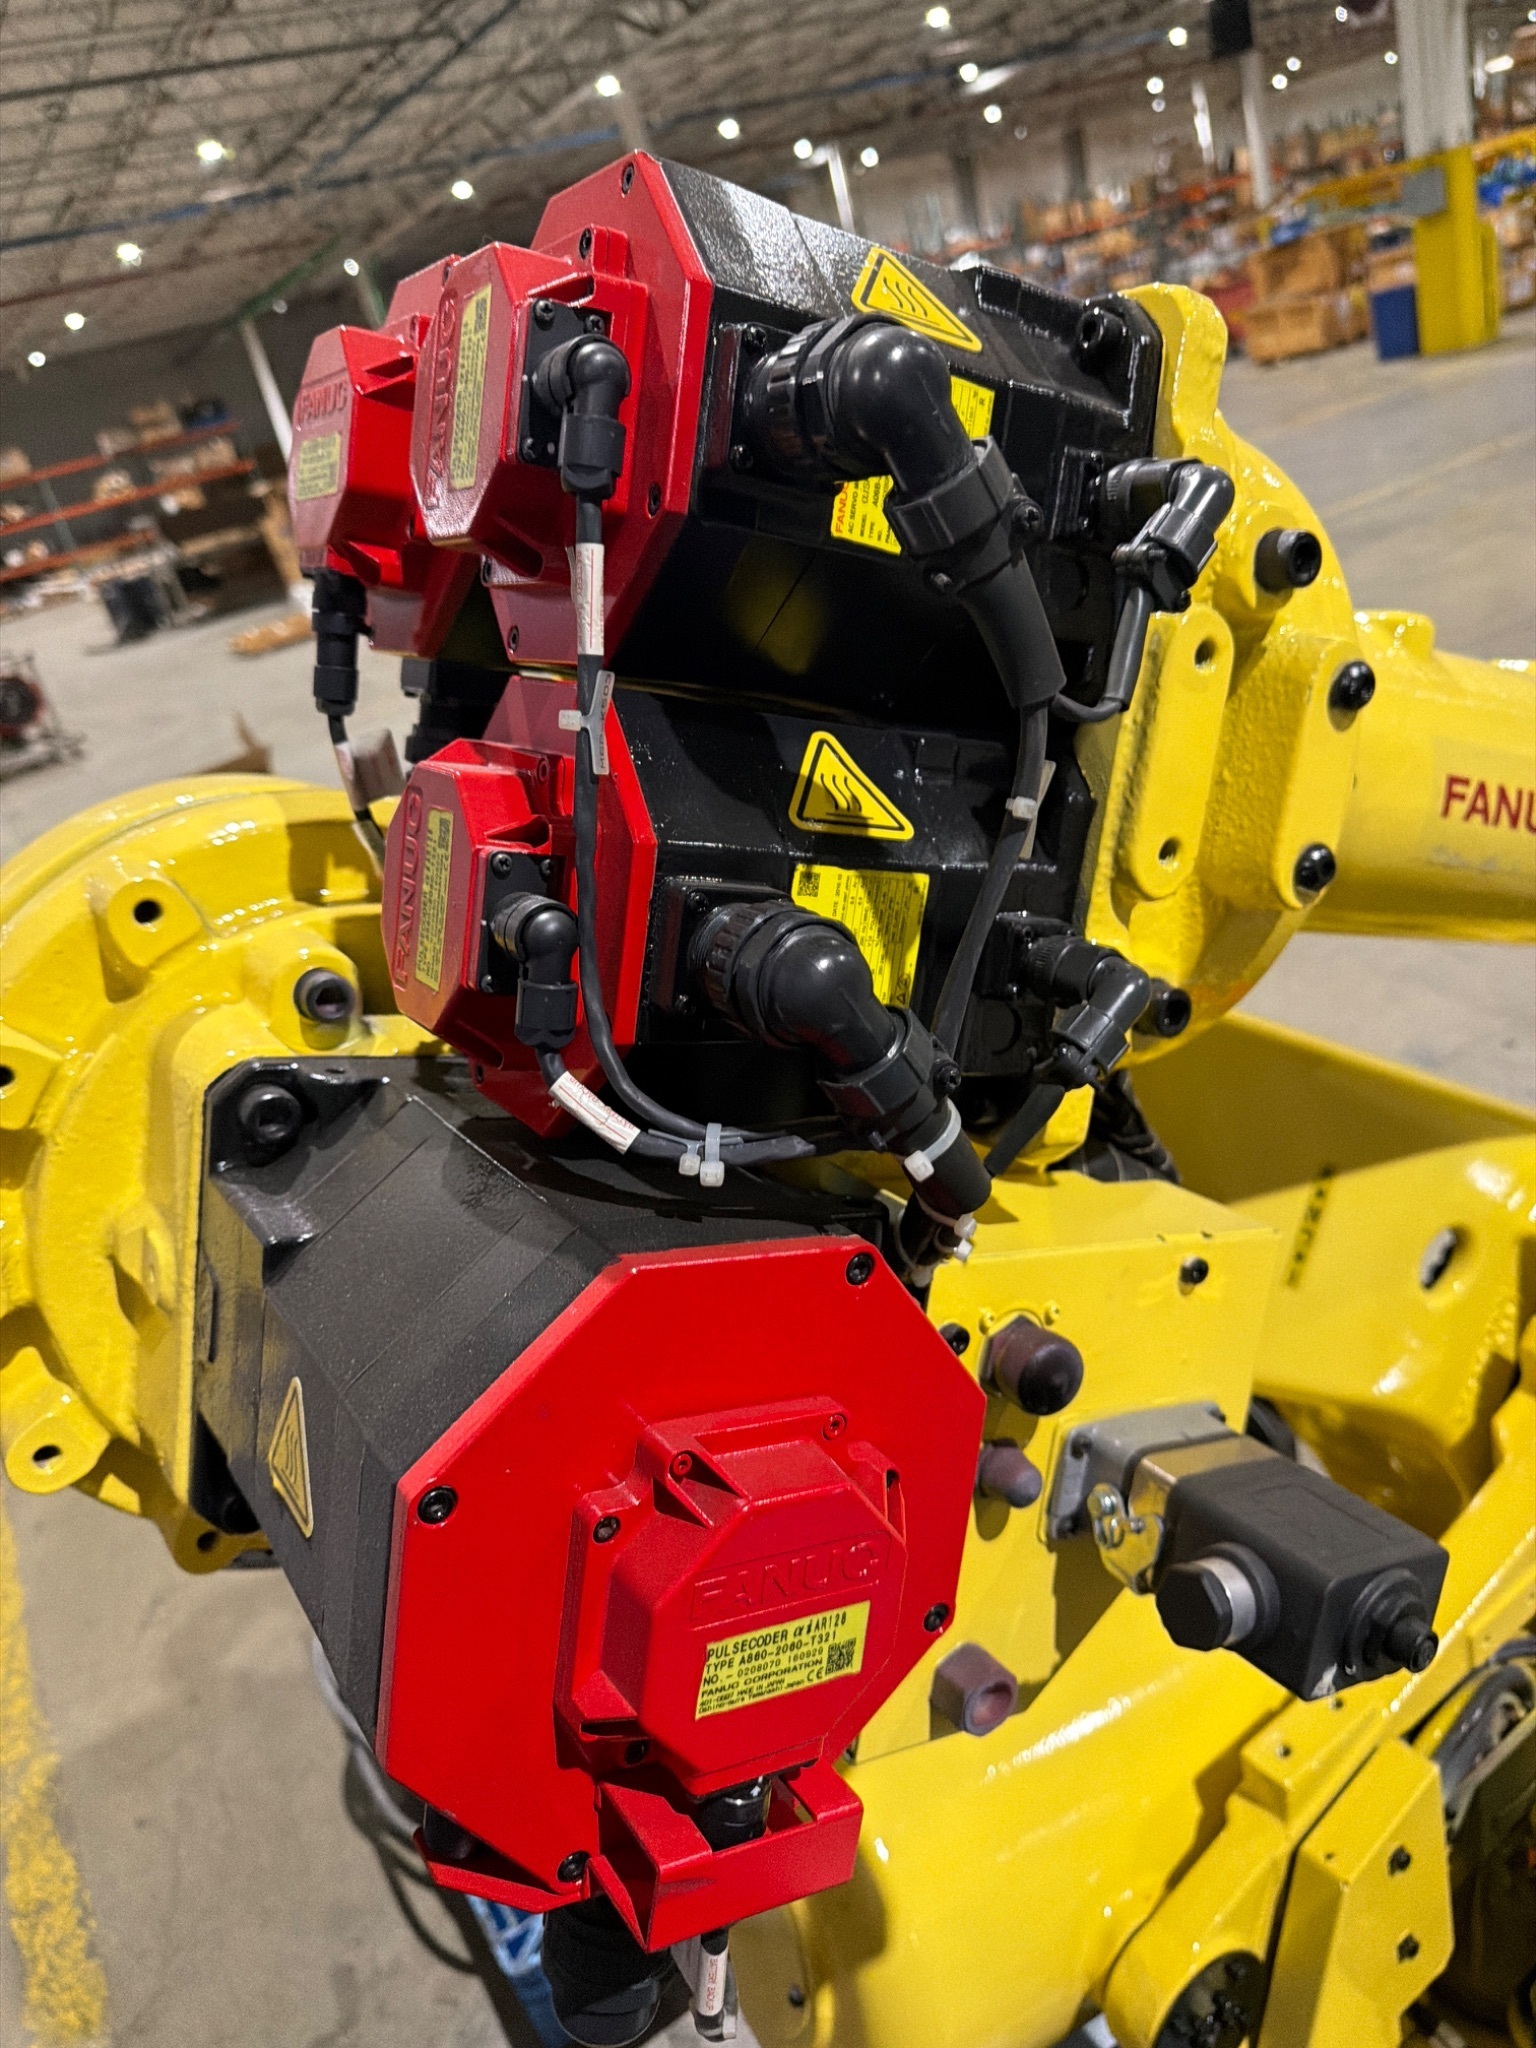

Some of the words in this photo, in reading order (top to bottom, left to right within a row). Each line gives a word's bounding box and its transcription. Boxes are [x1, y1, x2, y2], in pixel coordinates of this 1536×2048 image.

[424, 298, 456, 509] FANUC
[850, 491, 858, 519] SERVO
[393, 793, 422, 991] FANUC
[690, 1541, 879, 1621] FANUC
[706, 1658, 734, 1674] TYPE
[739, 1631, 836, 1666] A860-2060-T321
[707, 1630, 788, 1661] PULSECODER
[701, 1682, 740, 1698] FANUC
[744, 1659, 823, 1685] CORPORATION
[737, 1660, 781, 1678] 0208070
